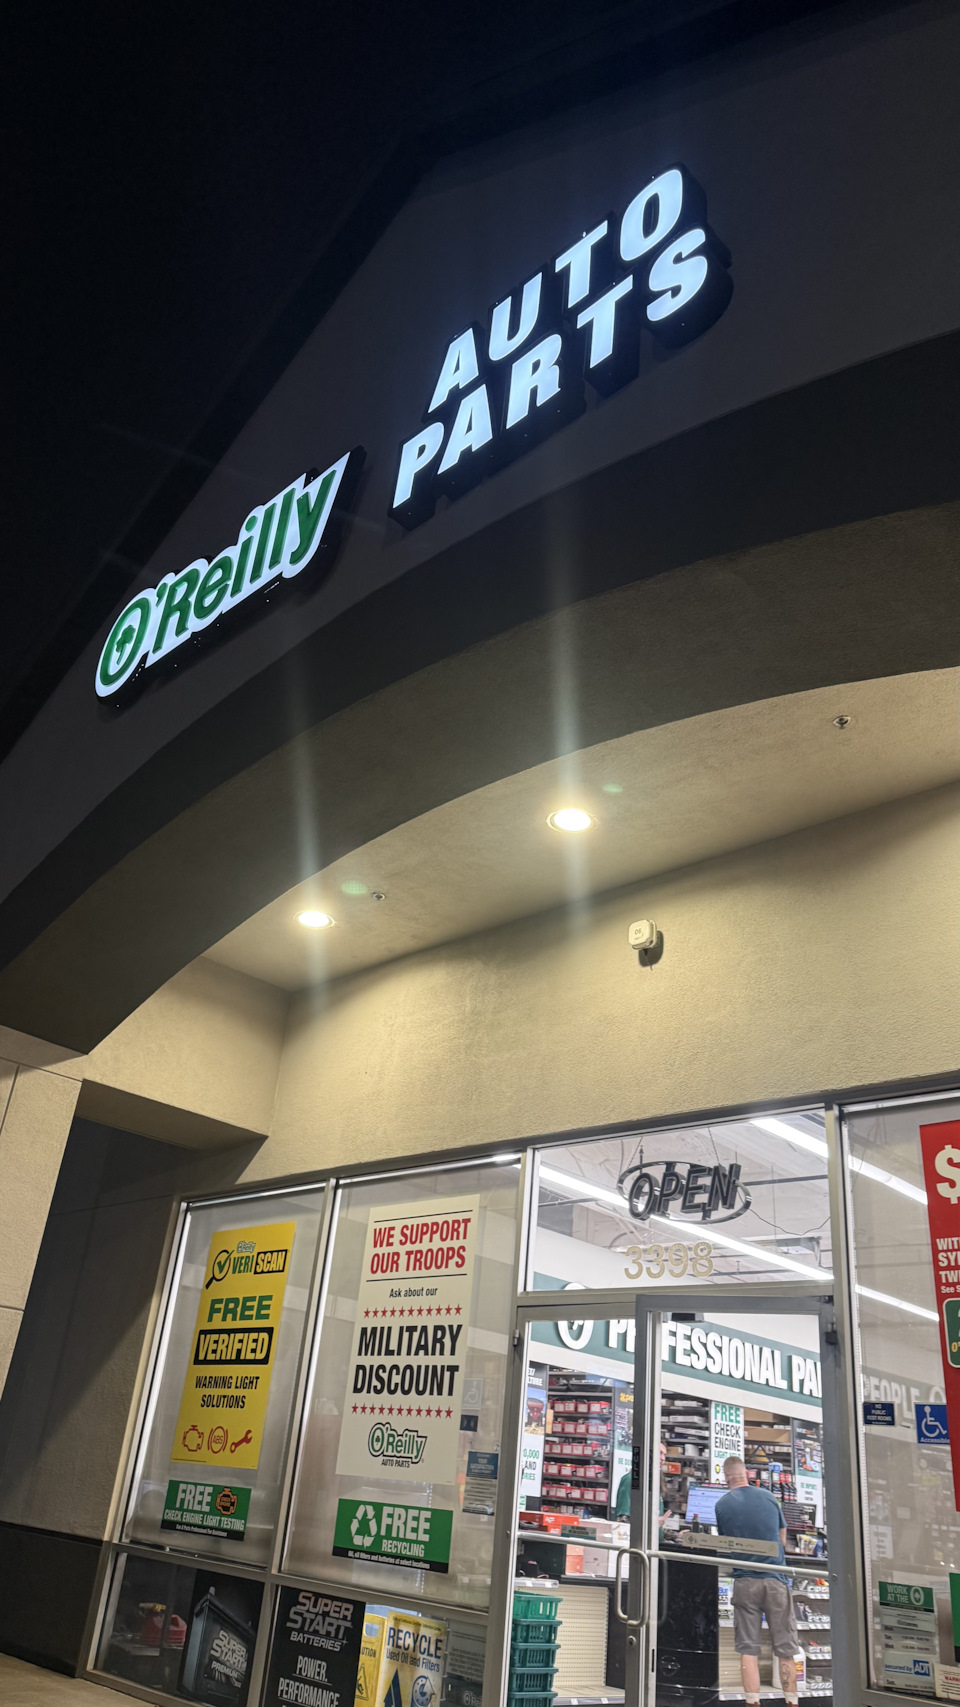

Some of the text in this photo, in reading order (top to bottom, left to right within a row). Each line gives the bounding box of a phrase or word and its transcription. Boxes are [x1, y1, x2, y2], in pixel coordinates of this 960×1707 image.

[428, 169, 683, 413] AUTO
[393, 228, 708, 508] PARTS
[98, 466, 340, 689] O'Reilly
[629, 1163, 741, 1221] OPEN
[372, 1218, 472, 1248] WE SUPPORT
[936, 1237, 960, 1250] WIT
[255, 1251, 286, 1273] SCAN
[370, 1245, 466, 1274] OUR TROOPS
[624, 1242, 714, 1279] 3398
[389, 1287, 438, 1298] Ask about our
[941, 1285, 955, 1293] See
[207, 1295, 273, 1322] FREE
[198, 1332, 270, 1361] VERIFIED
[357, 1324, 463, 1356] MILITARY
[195, 1376, 260, 1390] WARNING LIGHT
[352, 1364, 460, 1396] DISCOUNT
[200, 1394, 246, 1409] SOLUTIONS
[714, 1403, 741, 1424] FREE
[369, 1425, 426, 1461] O'Reilly
[714, 1422, 741, 1439] CHECK
[714, 1436, 742, 1452] ENGINE
[381, 1458, 411, 1468] AUTO PARTS
[175, 1483, 213, 1512] FREE
[164, 1509, 245, 1531] CHECK ENGINE LIGHT TESTING
[380, 1506, 432, 1542] FREE
[382, 1539, 425, 1557] RECYCLING
[886, 1584, 908, 1595] WORK
[887, 1593, 909, 1604] AT THE
[295, 1591, 354, 1620] SUPER
[285, 1606, 354, 1639] START
[210, 1638, 246, 1668] START
[219, 1630, 247, 1658] SUPER
[290, 1631, 342, 1652] BATTERIES
[361, 1647, 377, 1658] UTION
[386, 1626, 443, 1660] RECYCLE
[211, 1660, 239, 1678] PREMIUM
[296, 1655, 328, 1682] POWER.
[386, 1647, 400, 1662] Used
[401, 1652, 410, 1664] Oil
[409, 1654, 421, 1668] and
[421, 1657, 440, 1673] Filters
[906, 1665, 913, 1673] by
[914, 1661, 930, 1674] ADT
[278, 1677, 341, 1707] PERFORMANCE
